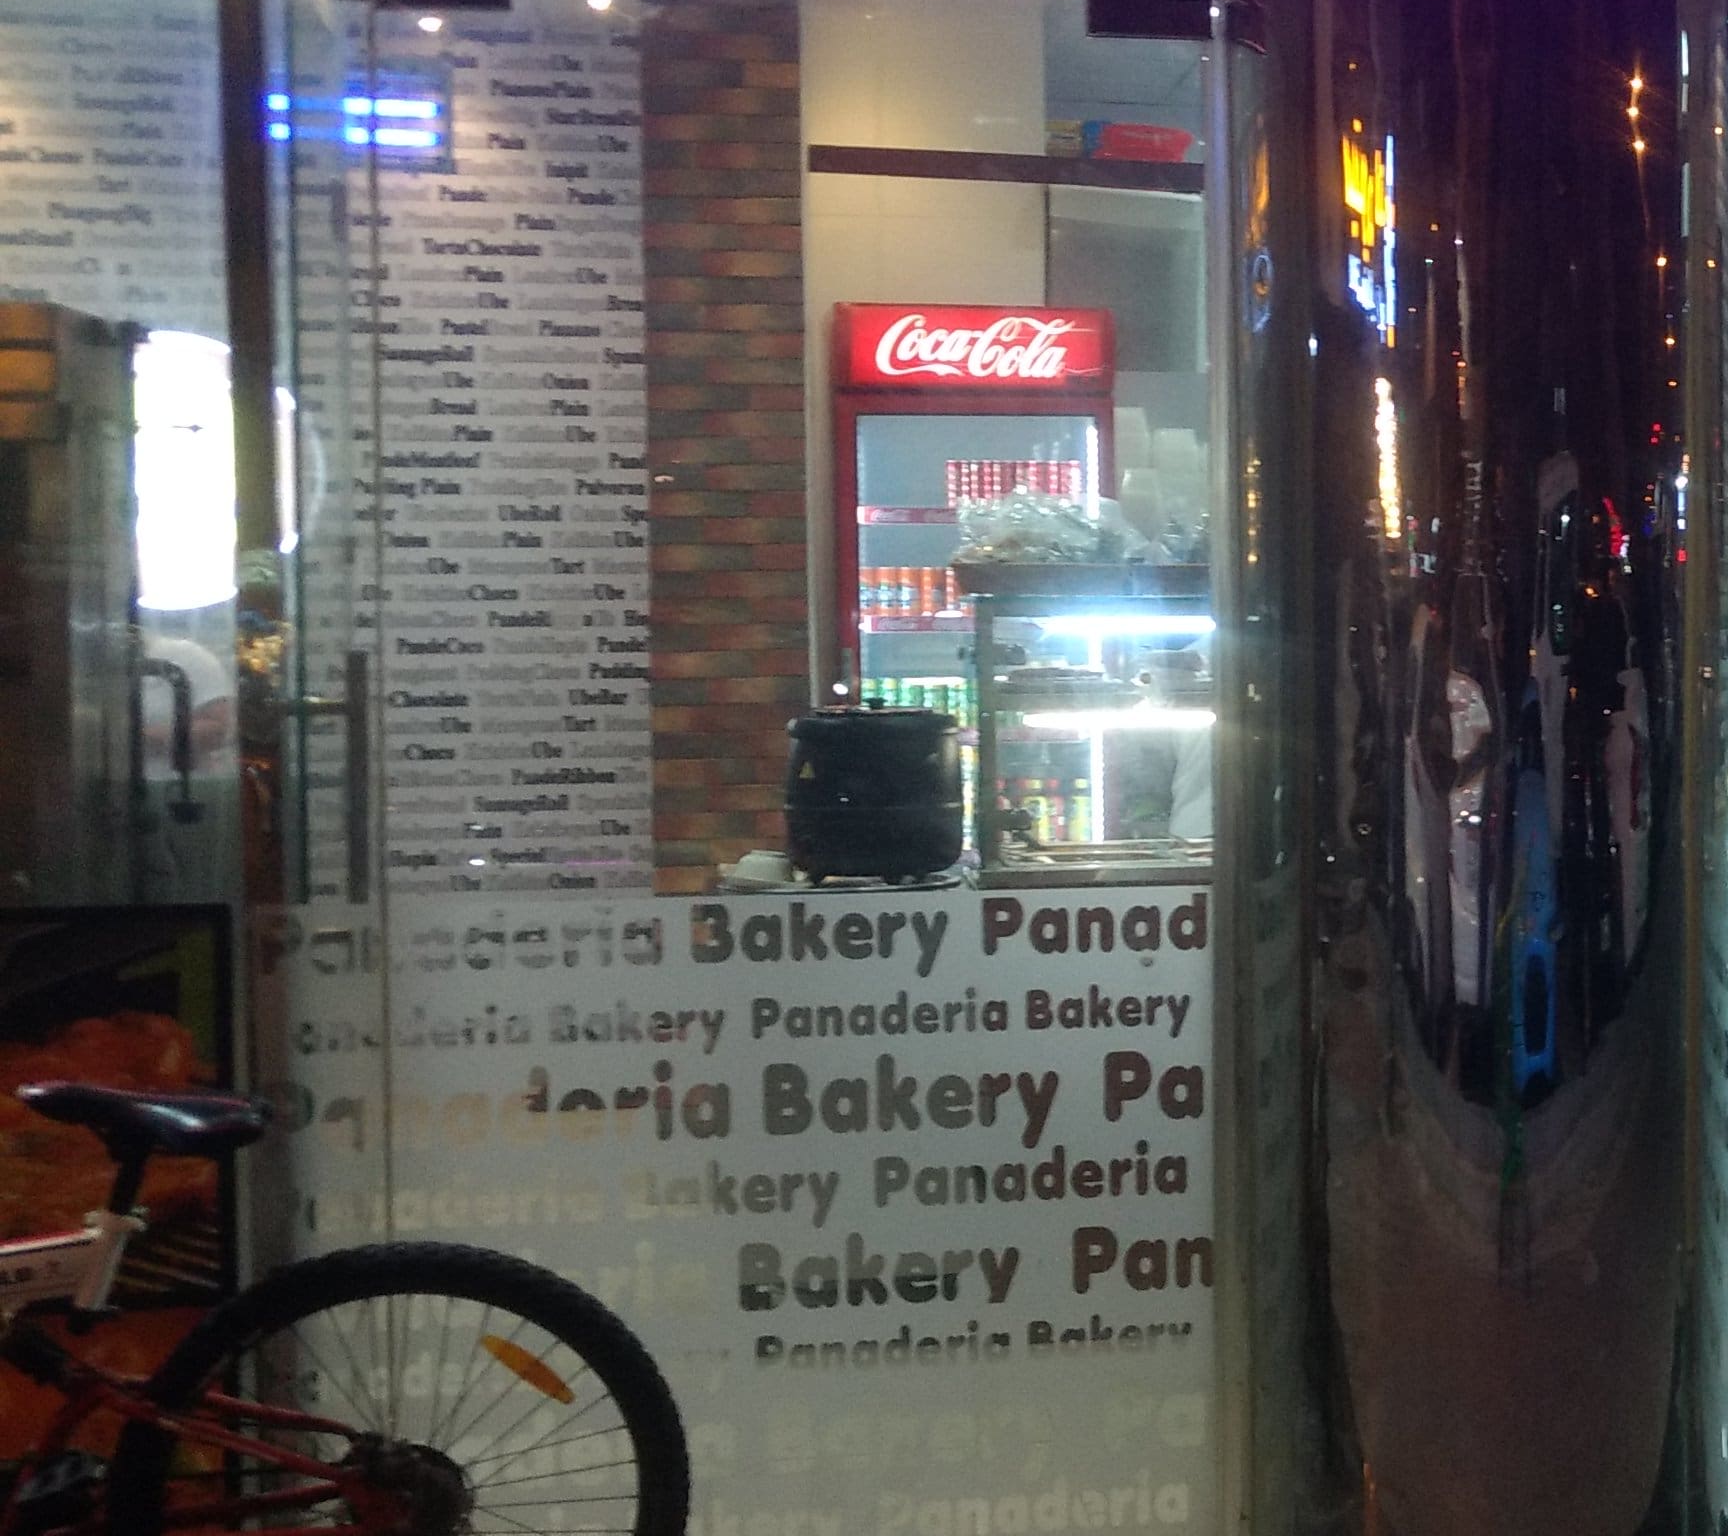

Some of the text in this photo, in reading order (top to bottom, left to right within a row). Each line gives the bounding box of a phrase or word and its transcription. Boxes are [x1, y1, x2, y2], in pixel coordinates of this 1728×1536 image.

[690, 902, 948, 978] Bakery
[982, 892, 1208, 956] Panad
[548, 997, 725, 1054] Bakery
[752, 987, 1008, 1040] Panaderia
[1026, 984, 1191, 1038] Bakery
[762, 1053, 1060, 1149] Bakery
[1103, 1050, 1205, 1123] Pa
[874, 1140, 1189, 1208] Panaderia
[738, 1231, 1021, 1311] Bakery
[755, 1320, 1012, 1371] Panaderia
[1026, 1314, 1195, 1359] Bakery
